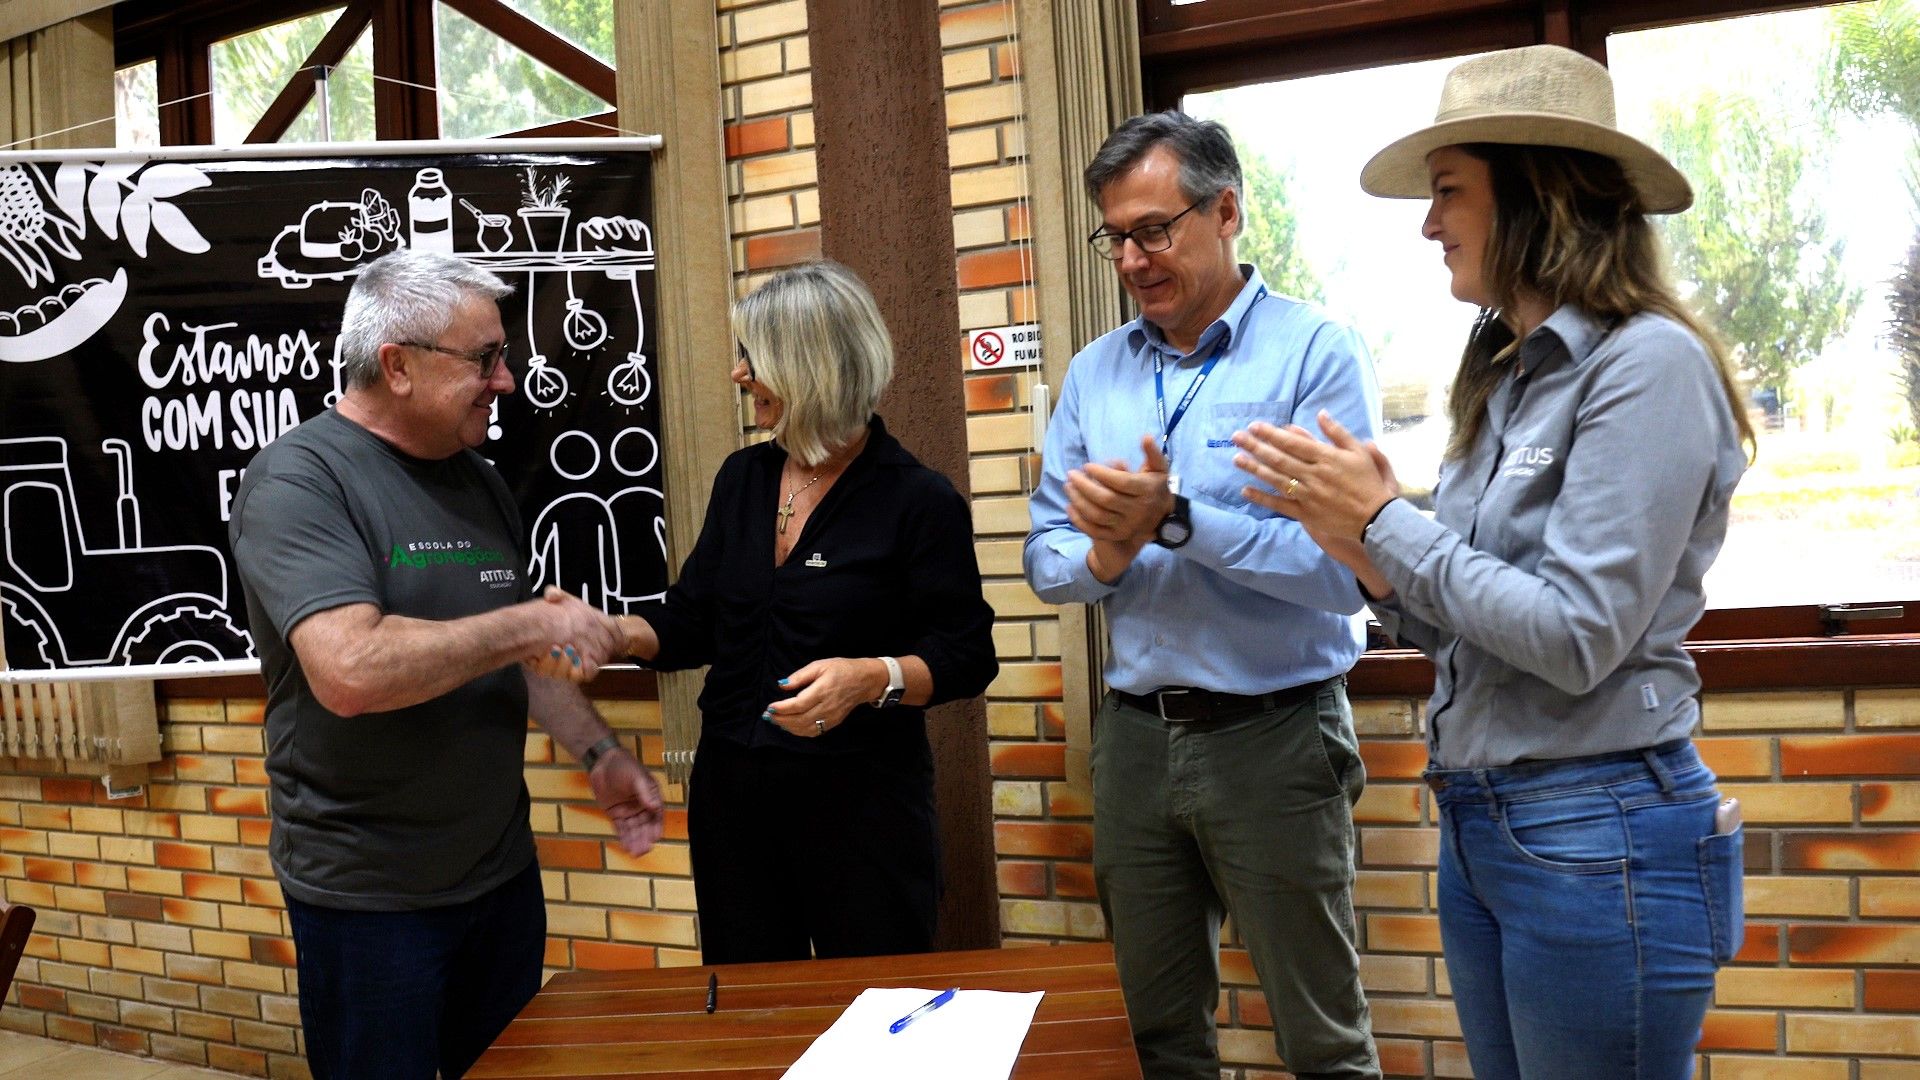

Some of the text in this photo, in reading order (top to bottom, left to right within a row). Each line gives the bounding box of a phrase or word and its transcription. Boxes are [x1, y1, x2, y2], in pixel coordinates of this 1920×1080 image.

[138, 311, 320, 389] Estamos
[142, 388, 301, 452] COM SUA
[409, 540, 472, 551] ESCOLA DO
[480, 569, 515, 583] ATITUS
